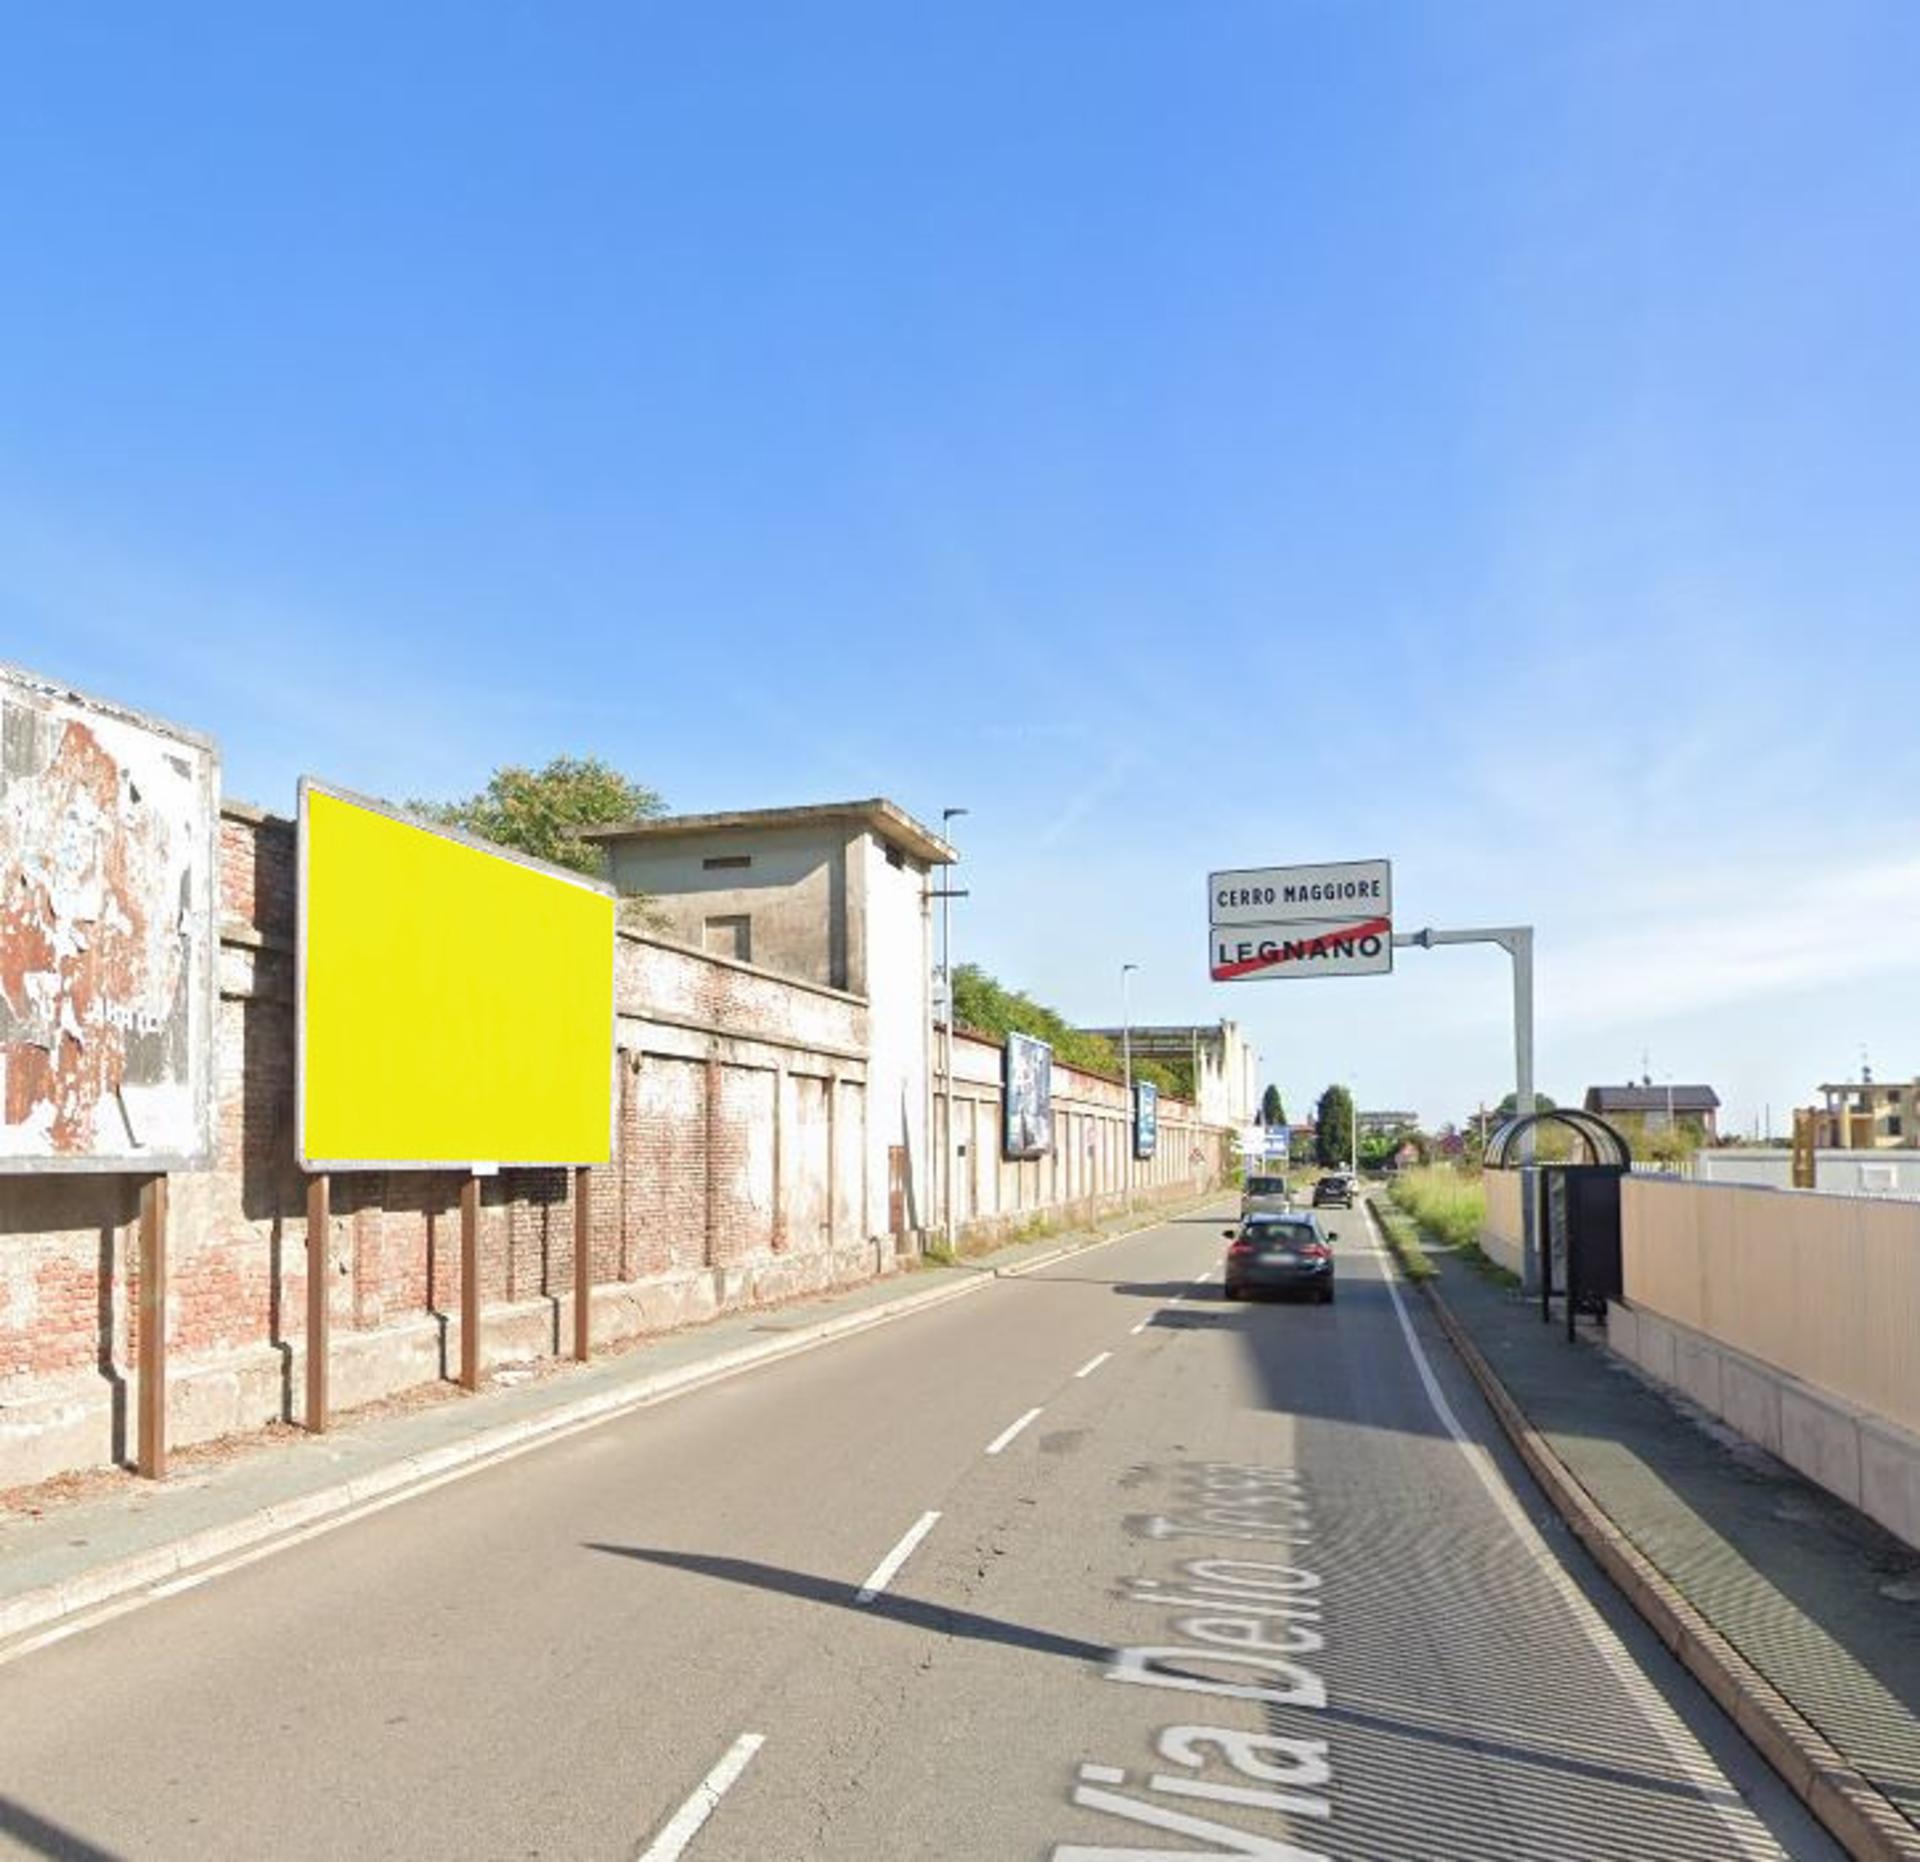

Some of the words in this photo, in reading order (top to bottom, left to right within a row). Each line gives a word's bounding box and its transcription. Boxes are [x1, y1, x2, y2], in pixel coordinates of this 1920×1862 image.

[1217, 887, 1276, 908] CERRO
[1283, 879, 1381, 903] MAGGIORE
[1218, 935, 1382, 964] LEGNANO
